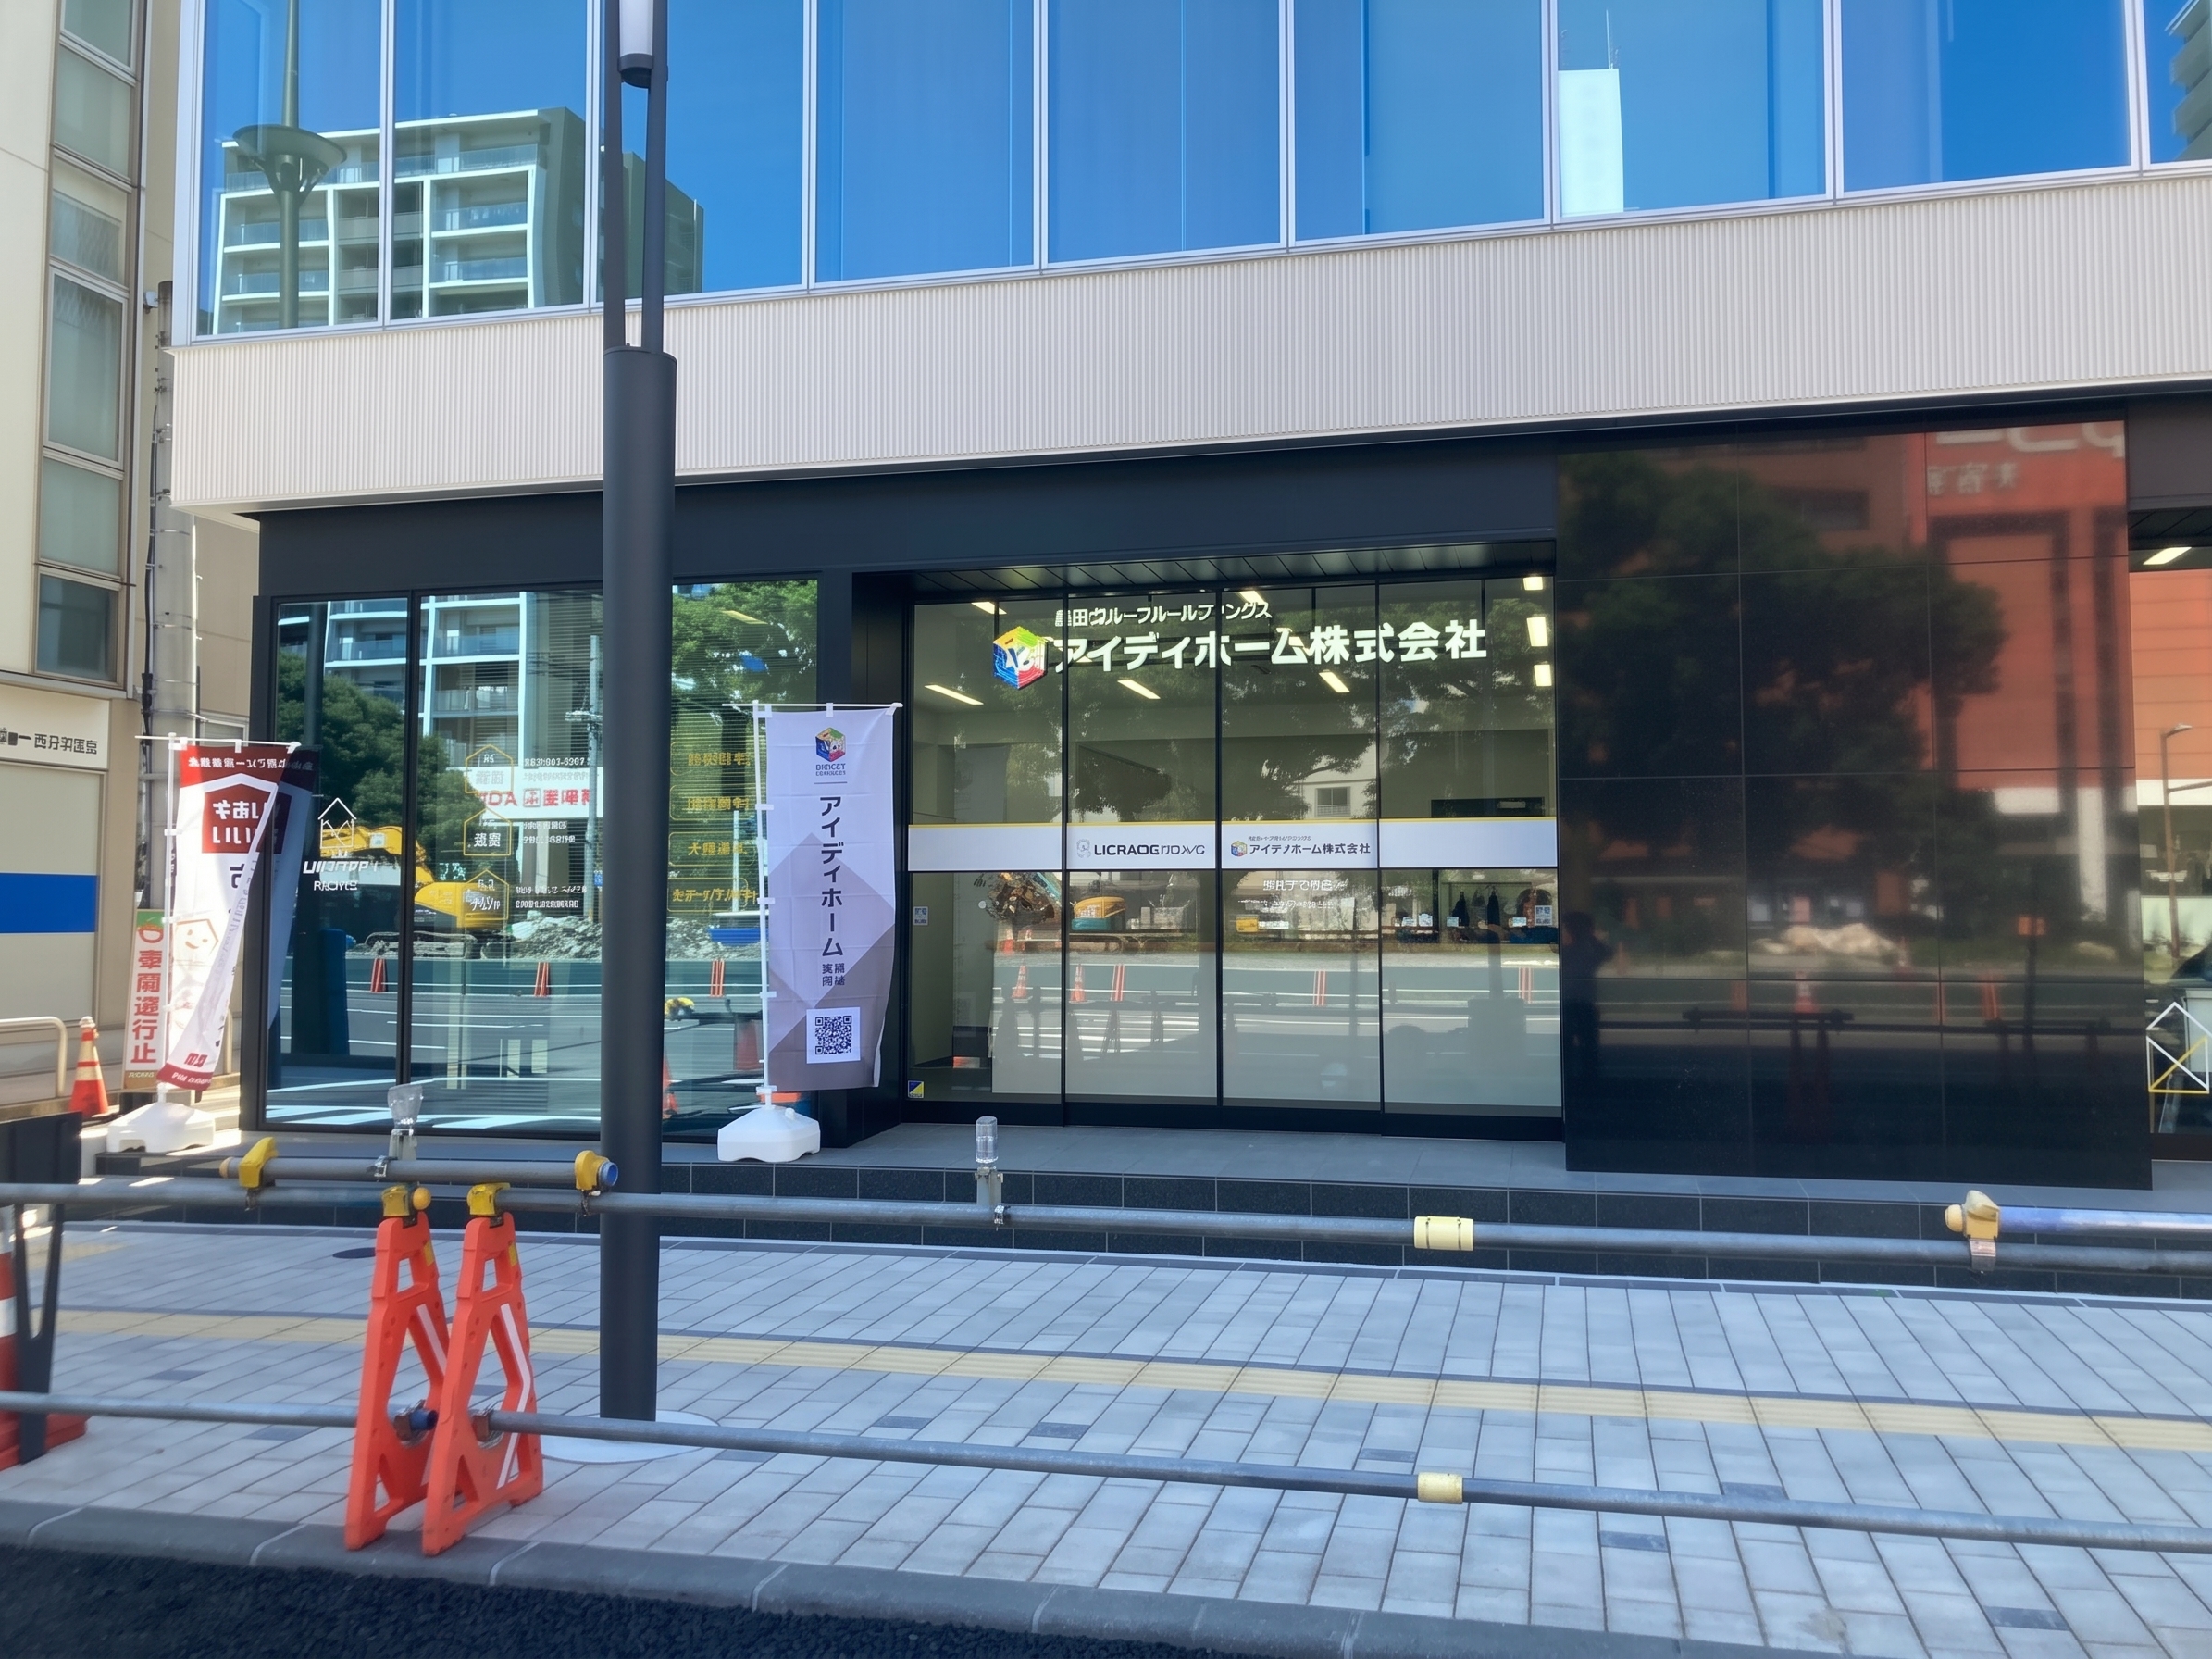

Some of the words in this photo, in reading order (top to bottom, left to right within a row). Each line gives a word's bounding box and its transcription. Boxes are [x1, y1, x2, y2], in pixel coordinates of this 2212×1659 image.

[1052, 618, 1488, 674] アイディホーム株式会社
[820, 796, 844, 957] アイディホーム
